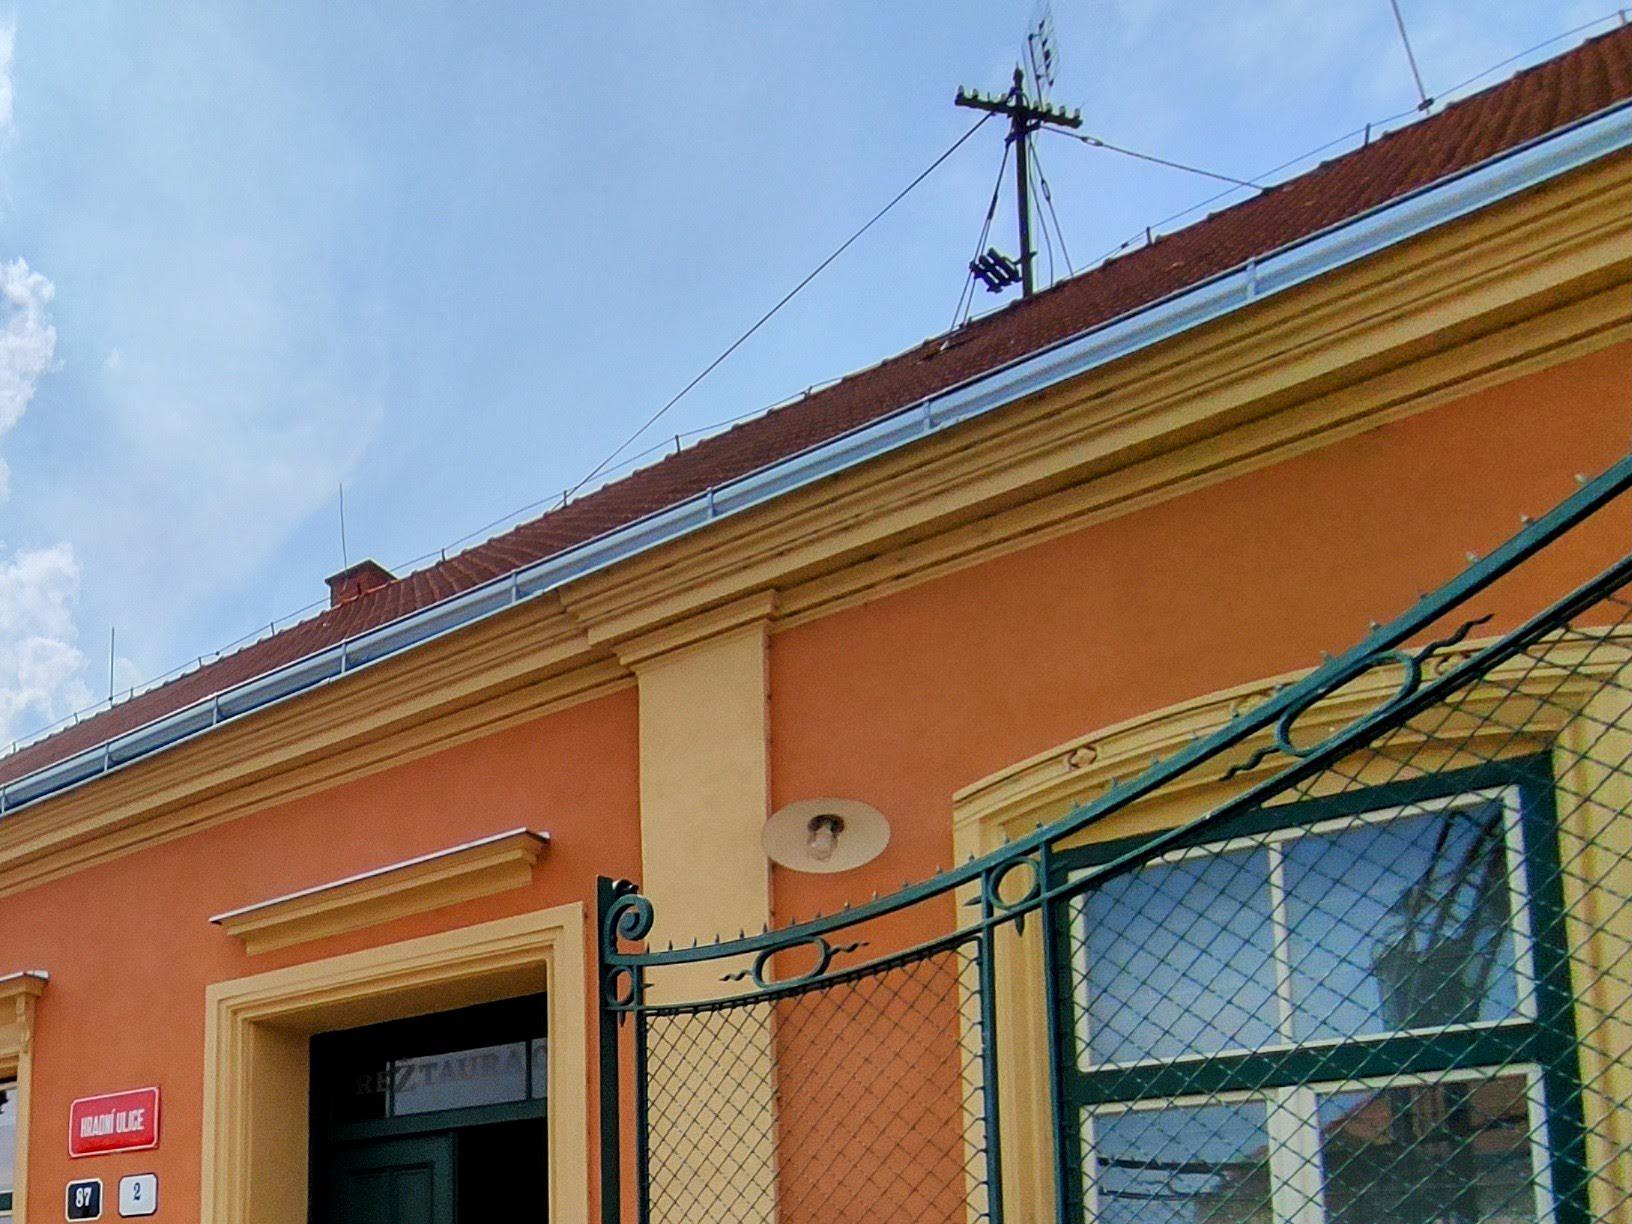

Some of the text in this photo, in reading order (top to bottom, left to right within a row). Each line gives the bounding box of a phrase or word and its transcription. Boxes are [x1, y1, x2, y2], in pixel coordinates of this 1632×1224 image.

[80, 1108, 145, 1138] HRADNÍ ULICE
[75, 1187, 92, 1208] 87
[133, 1182, 142, 1201] 2
